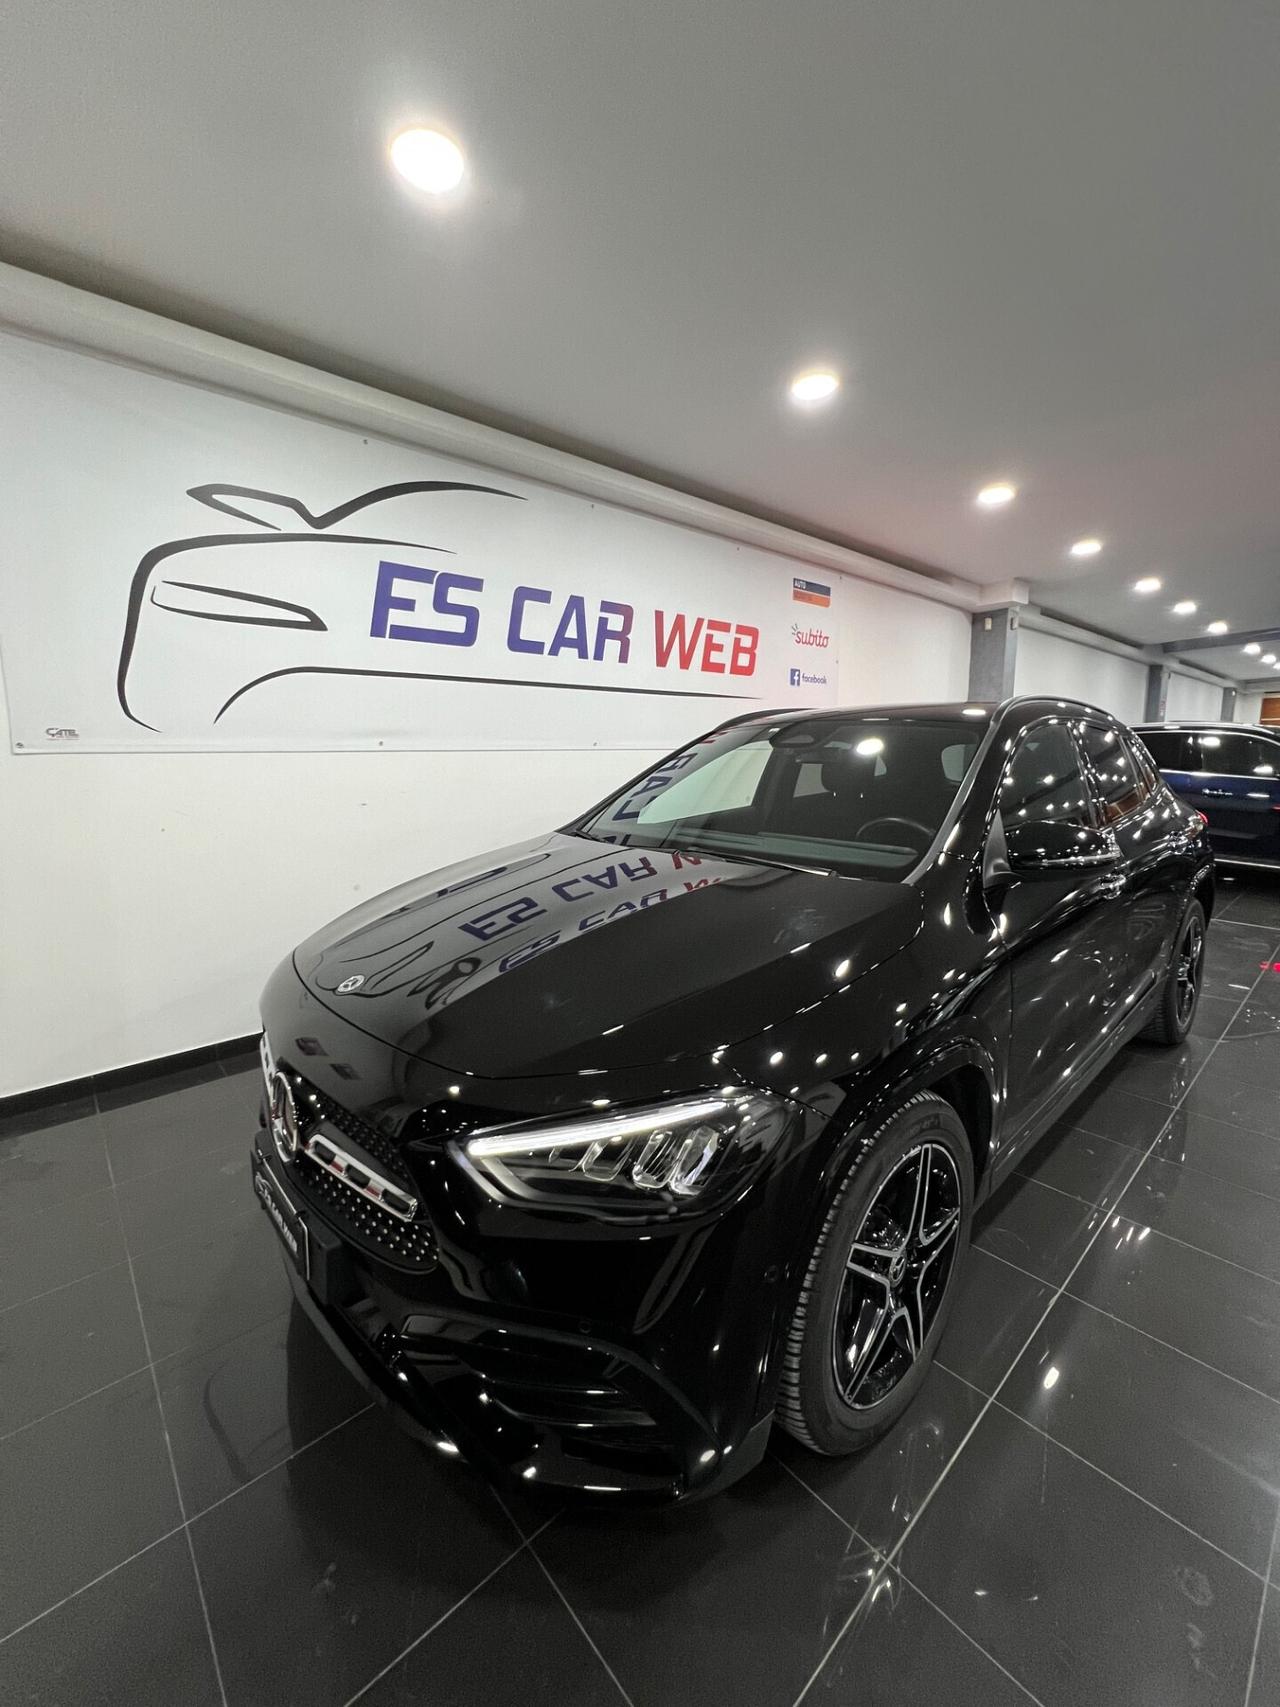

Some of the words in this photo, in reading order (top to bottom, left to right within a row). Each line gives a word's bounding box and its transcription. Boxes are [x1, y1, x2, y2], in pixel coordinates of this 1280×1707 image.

[370, 560, 484, 648] ES
[507, 586, 633, 664] CAR
[654, 609, 759, 677] WEB
[794, 628, 829, 648] subito
[801, 672, 827, 685] facebook
